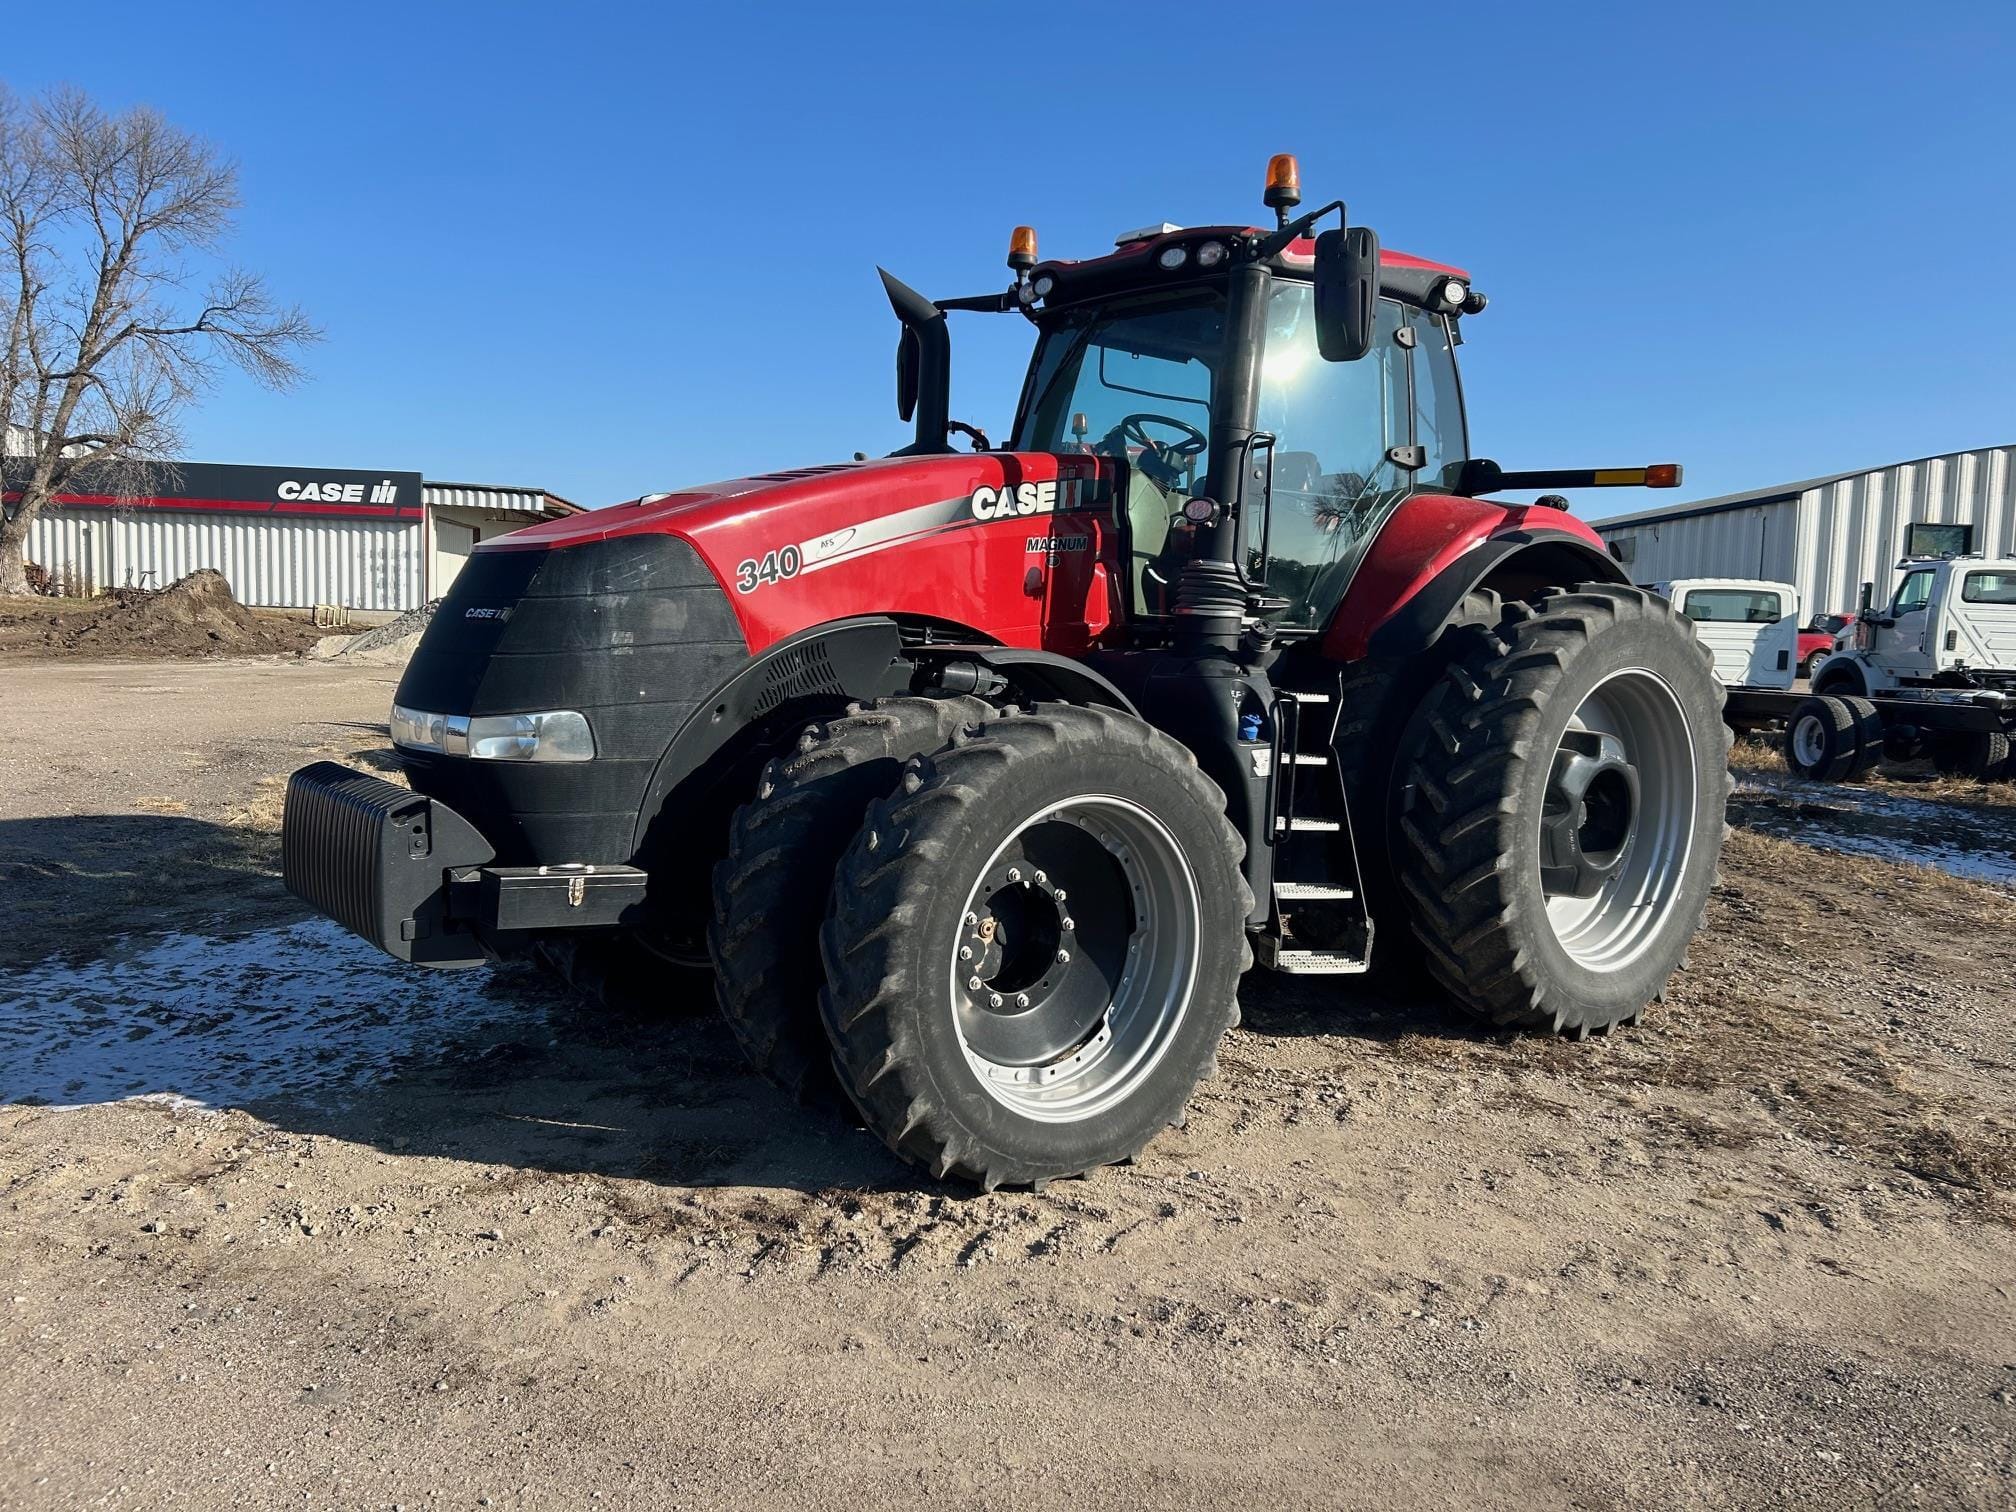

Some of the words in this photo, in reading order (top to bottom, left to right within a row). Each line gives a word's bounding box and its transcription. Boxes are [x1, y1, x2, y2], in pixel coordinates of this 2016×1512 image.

[277, 481, 364, 503] CASE
[971, 481, 1057, 520] CASE
[820, 538, 835, 549] AFS
[1026, 536, 1088, 553] MAGNUM
[736, 544, 801, 595] 340
[465, 607, 496, 618] CASE
